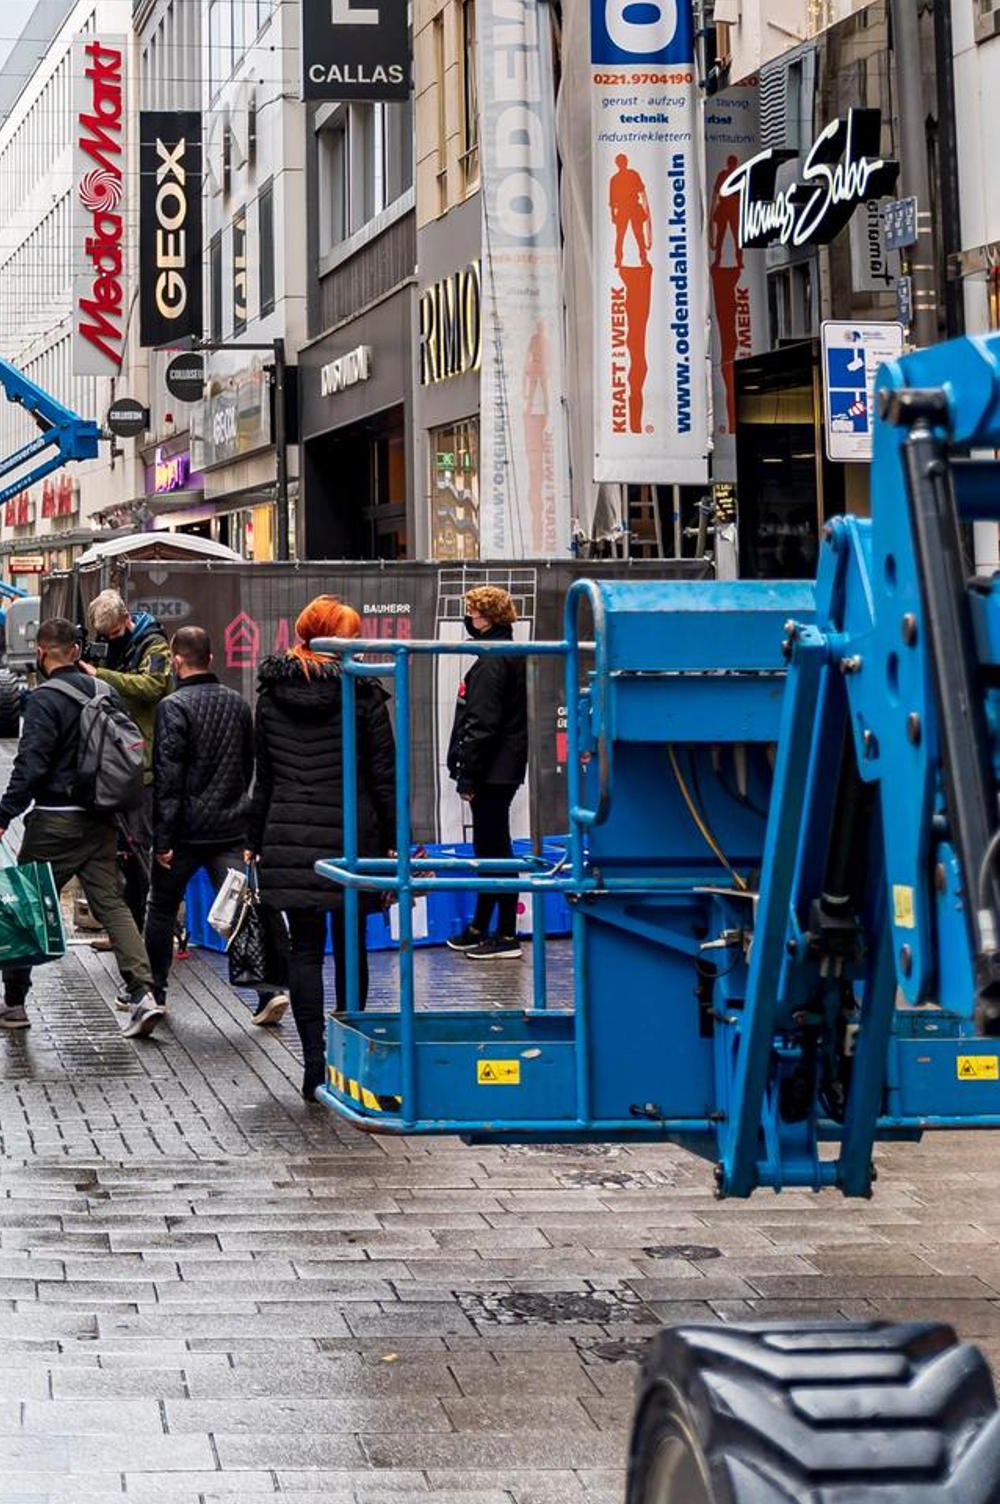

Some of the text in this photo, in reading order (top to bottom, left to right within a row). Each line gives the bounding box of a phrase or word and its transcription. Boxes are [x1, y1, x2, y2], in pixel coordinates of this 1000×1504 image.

[309, 64, 404, 84] CALLAS
[593, 73, 693, 85] 0221.9704190
[647, 96, 686, 108] aufzug
[620, 113, 669, 124] technik
[598, 131, 692, 142] industrieklettern
[719, 107, 884, 248] Thomas Sabo
[155, 137, 187, 320] GEOX
[667, 153, 691, 434] www.odendahl.koeln
[610, 287, 626, 348] WERK
[612, 363, 627, 433] KRAFT
[363, 603, 410, 614] BAUHERR
